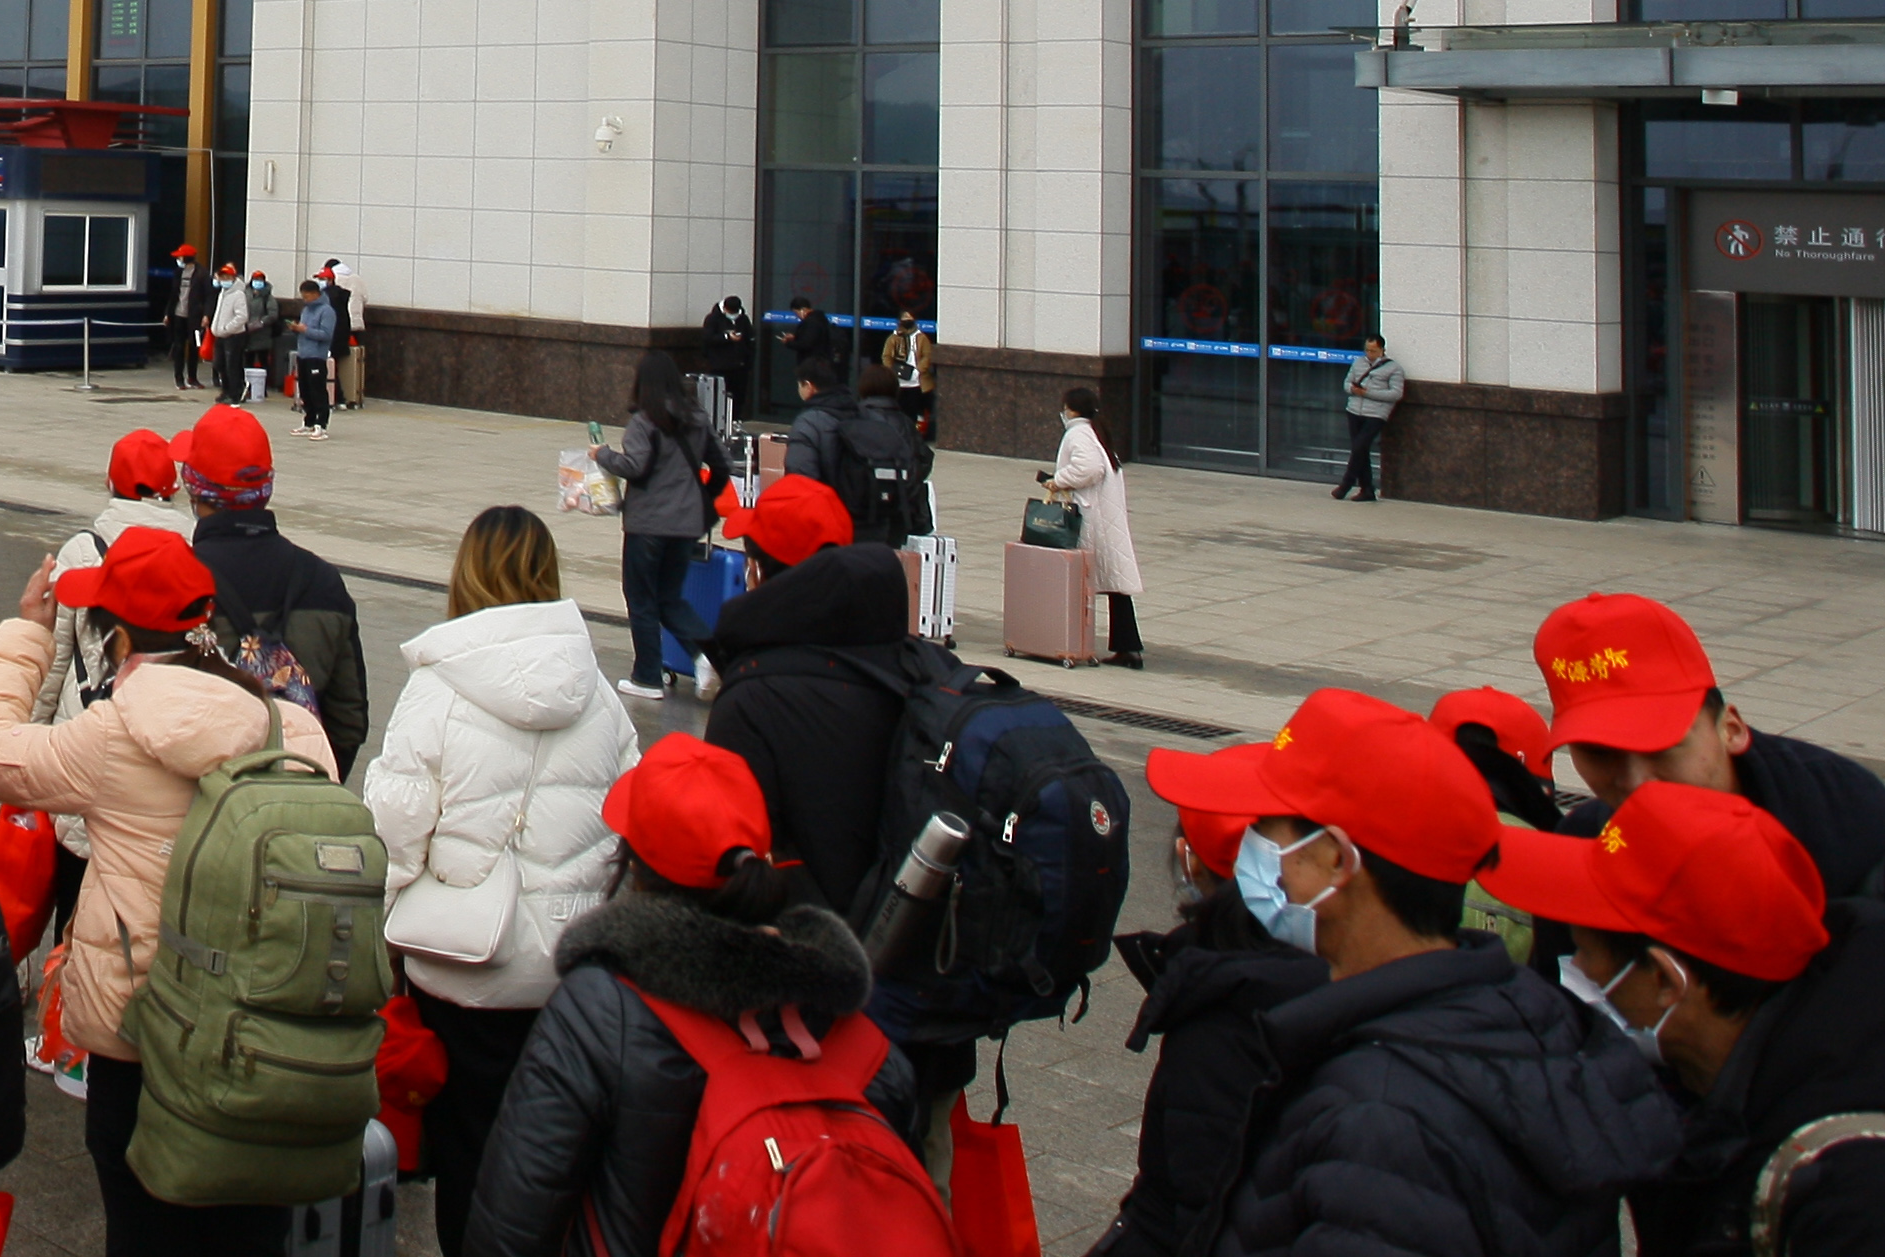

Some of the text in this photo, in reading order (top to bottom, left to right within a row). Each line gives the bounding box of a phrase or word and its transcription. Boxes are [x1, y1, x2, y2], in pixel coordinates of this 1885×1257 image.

[1775, 249, 1875, 263] No Thoroughfare
[882, 880, 908, 921] SORT
